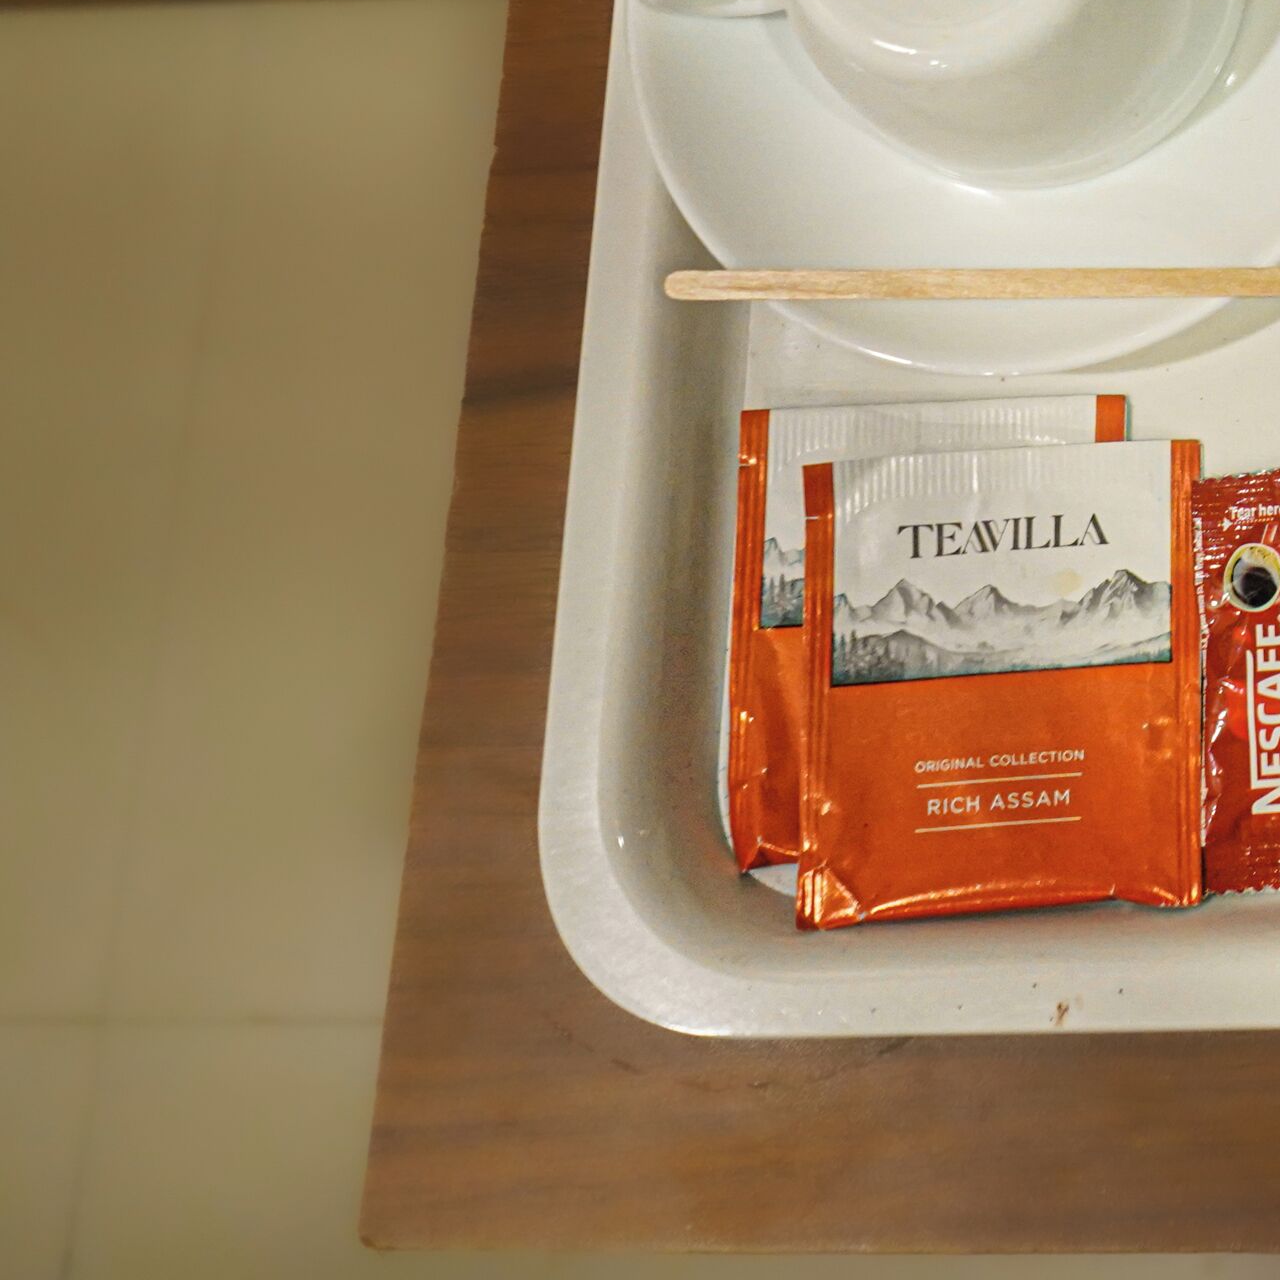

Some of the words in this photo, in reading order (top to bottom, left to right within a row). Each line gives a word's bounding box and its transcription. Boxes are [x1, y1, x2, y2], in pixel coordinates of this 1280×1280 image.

[897, 512, 1110, 559] TEAVILLA
[914, 756, 985, 773] ORIGINAL
[989, 749, 1086, 768] COLLECTION
[927, 795, 981, 816] RICH
[990, 788, 1071, 811] ASSAM
